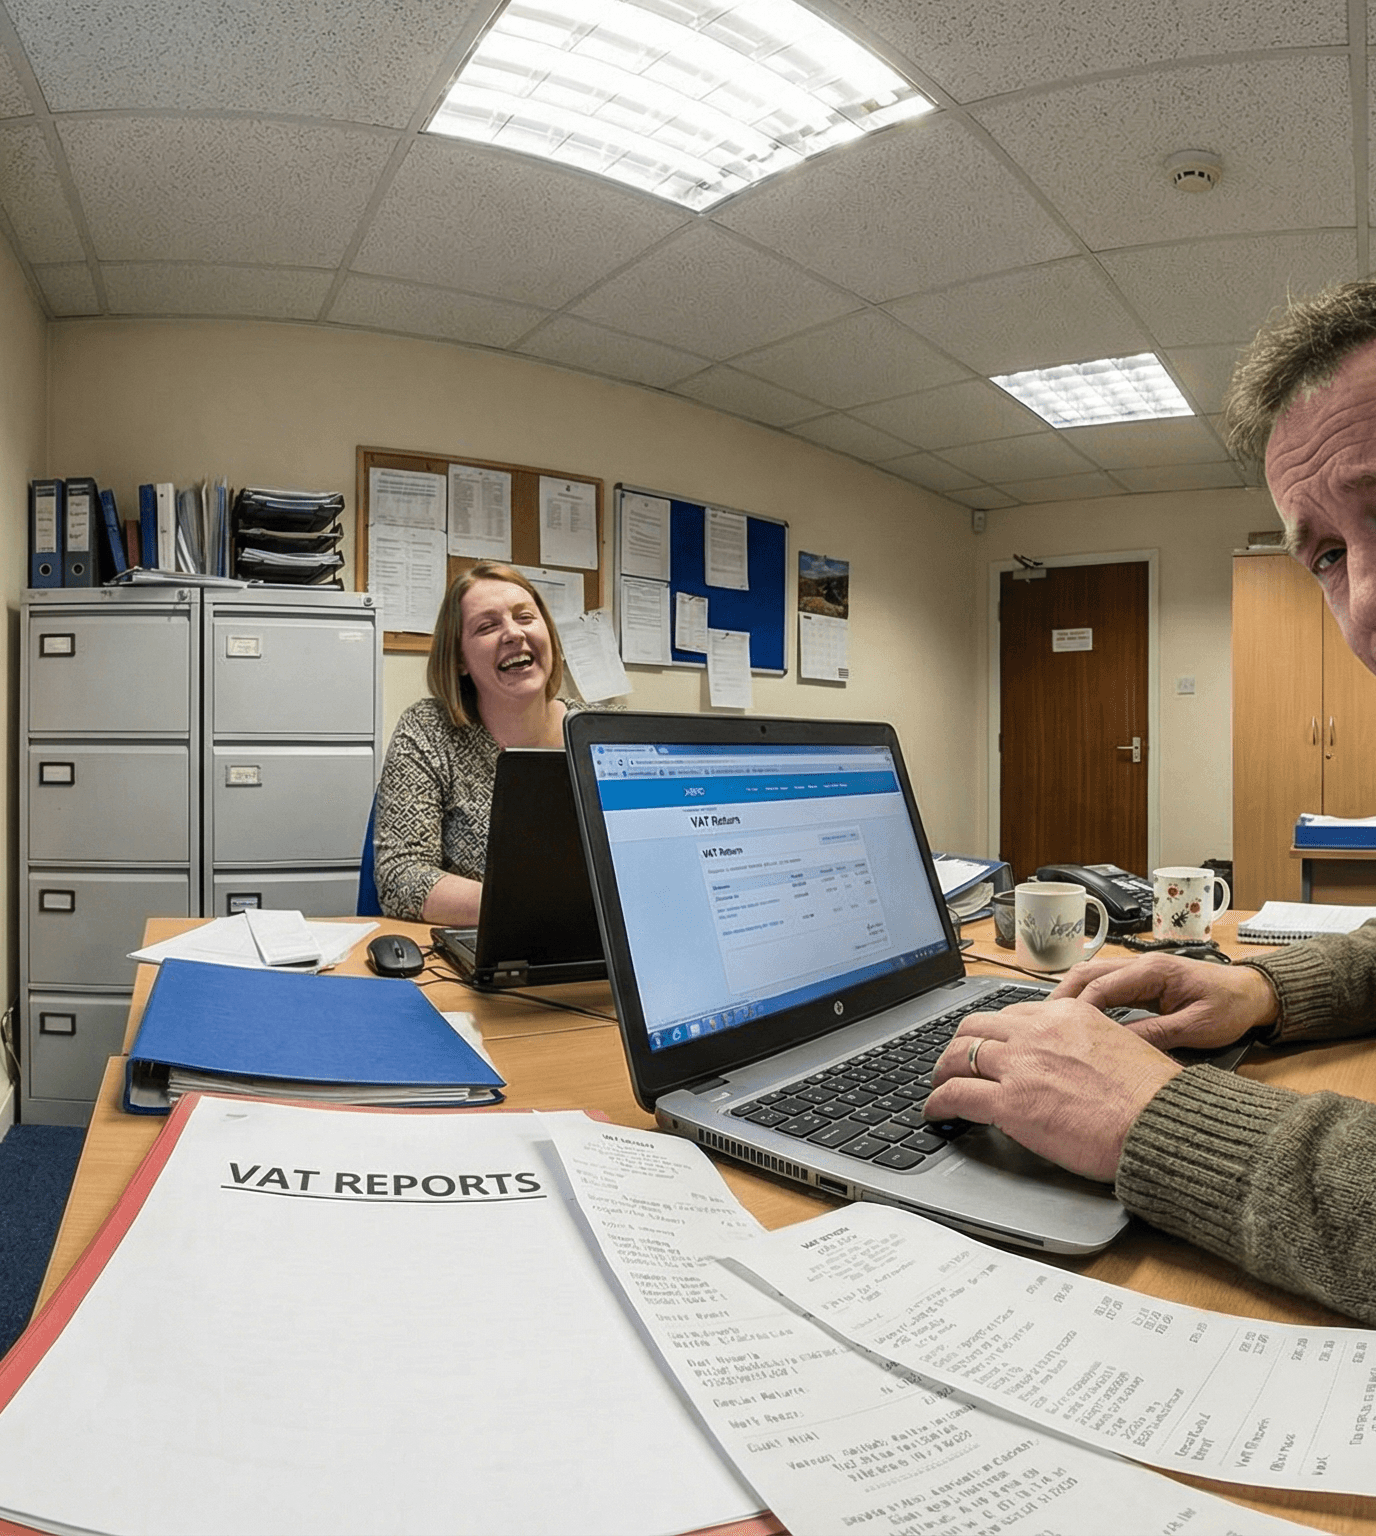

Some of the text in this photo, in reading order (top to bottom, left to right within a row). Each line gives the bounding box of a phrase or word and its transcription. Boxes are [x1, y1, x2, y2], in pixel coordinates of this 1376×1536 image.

[690, 815, 709, 828] VAT
[702, 848, 718, 858] VAT
[229, 1162, 542, 1197] VAT REPORTS
